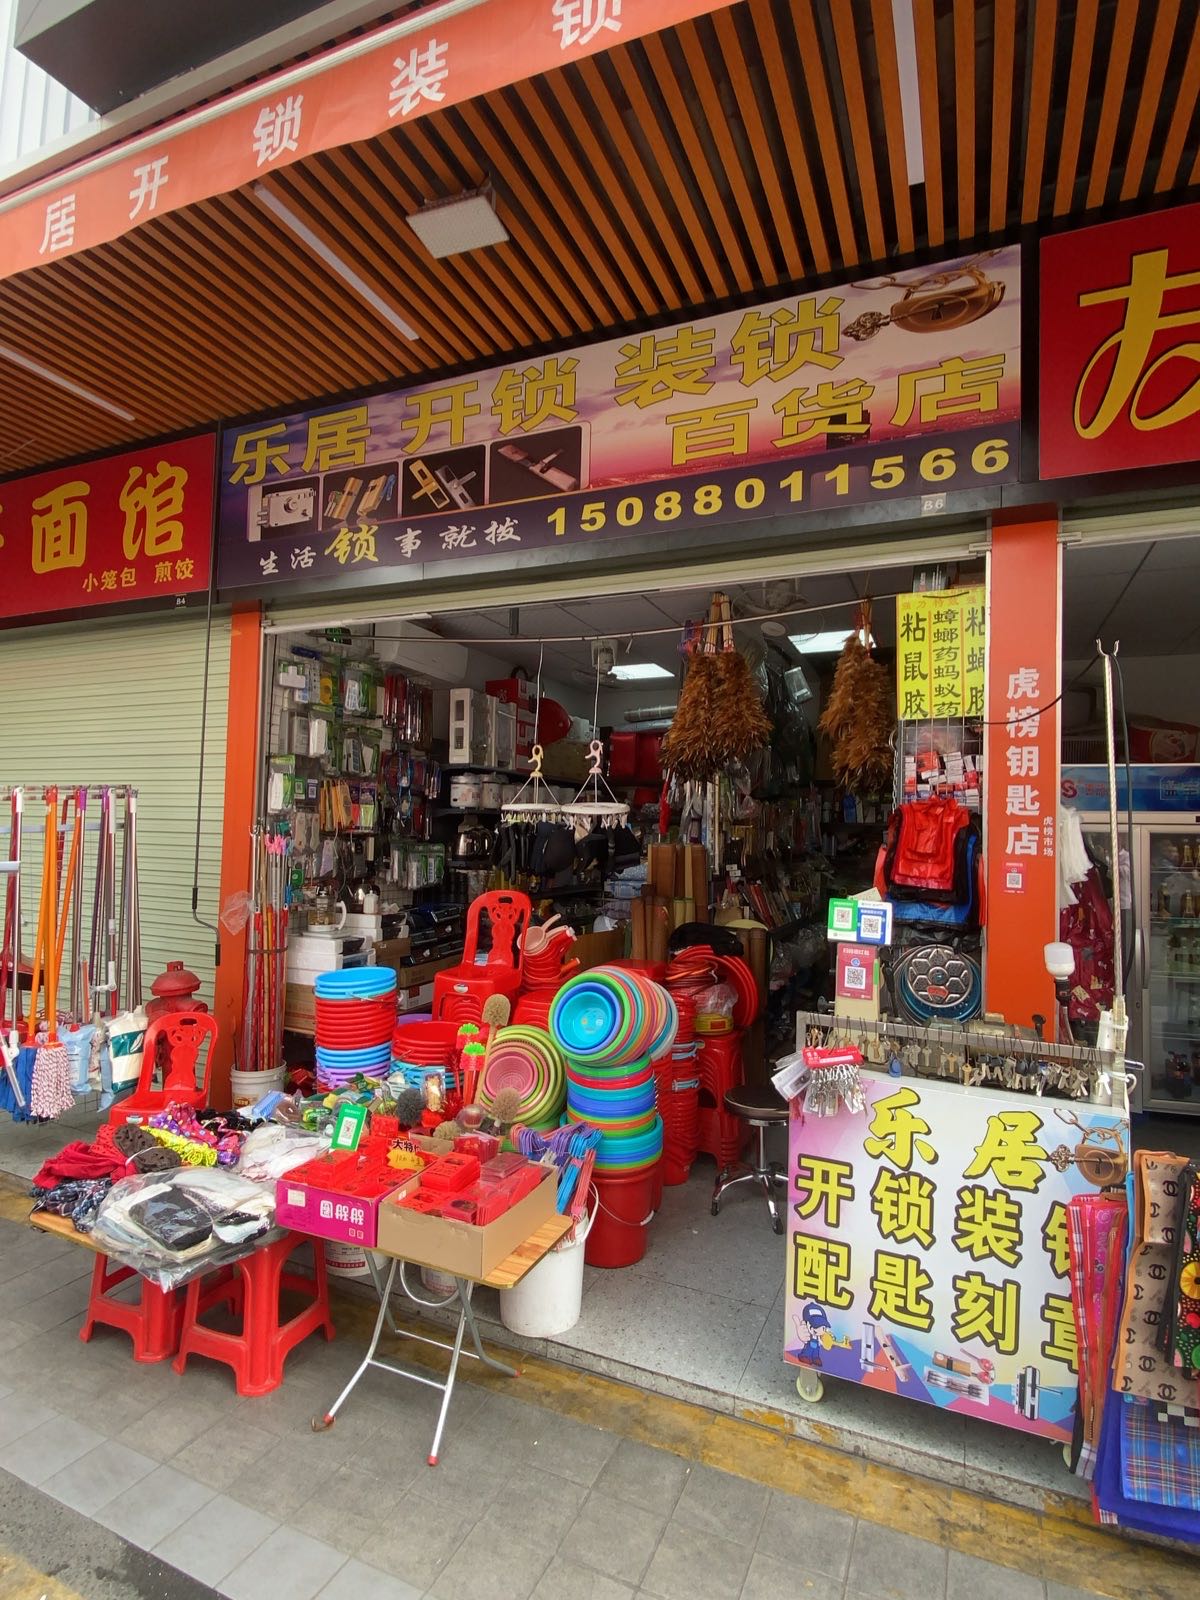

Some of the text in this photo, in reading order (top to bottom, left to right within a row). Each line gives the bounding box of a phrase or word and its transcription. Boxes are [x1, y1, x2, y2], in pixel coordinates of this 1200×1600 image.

[228, 296, 846, 486] 乐居开锁装锁
[665, 353, 1006, 466] 百货店
[0, 461, 188, 574] 面馆
[546, 438, 1011, 537] 15088011566
[923, 498, 944, 511] B6
[82, 558, 194, 592] 小笼包 煎饺
[900, 611, 929, 719] 粘鼠胶
[932, 608, 961, 717] 蟑螂药蚂蚁药
[1006, 667, 1040, 856] 虎榜钥匙店
[1043, 815, 1054, 857] 虎榜市场
[863, 1087, 1049, 1192] 乐居
